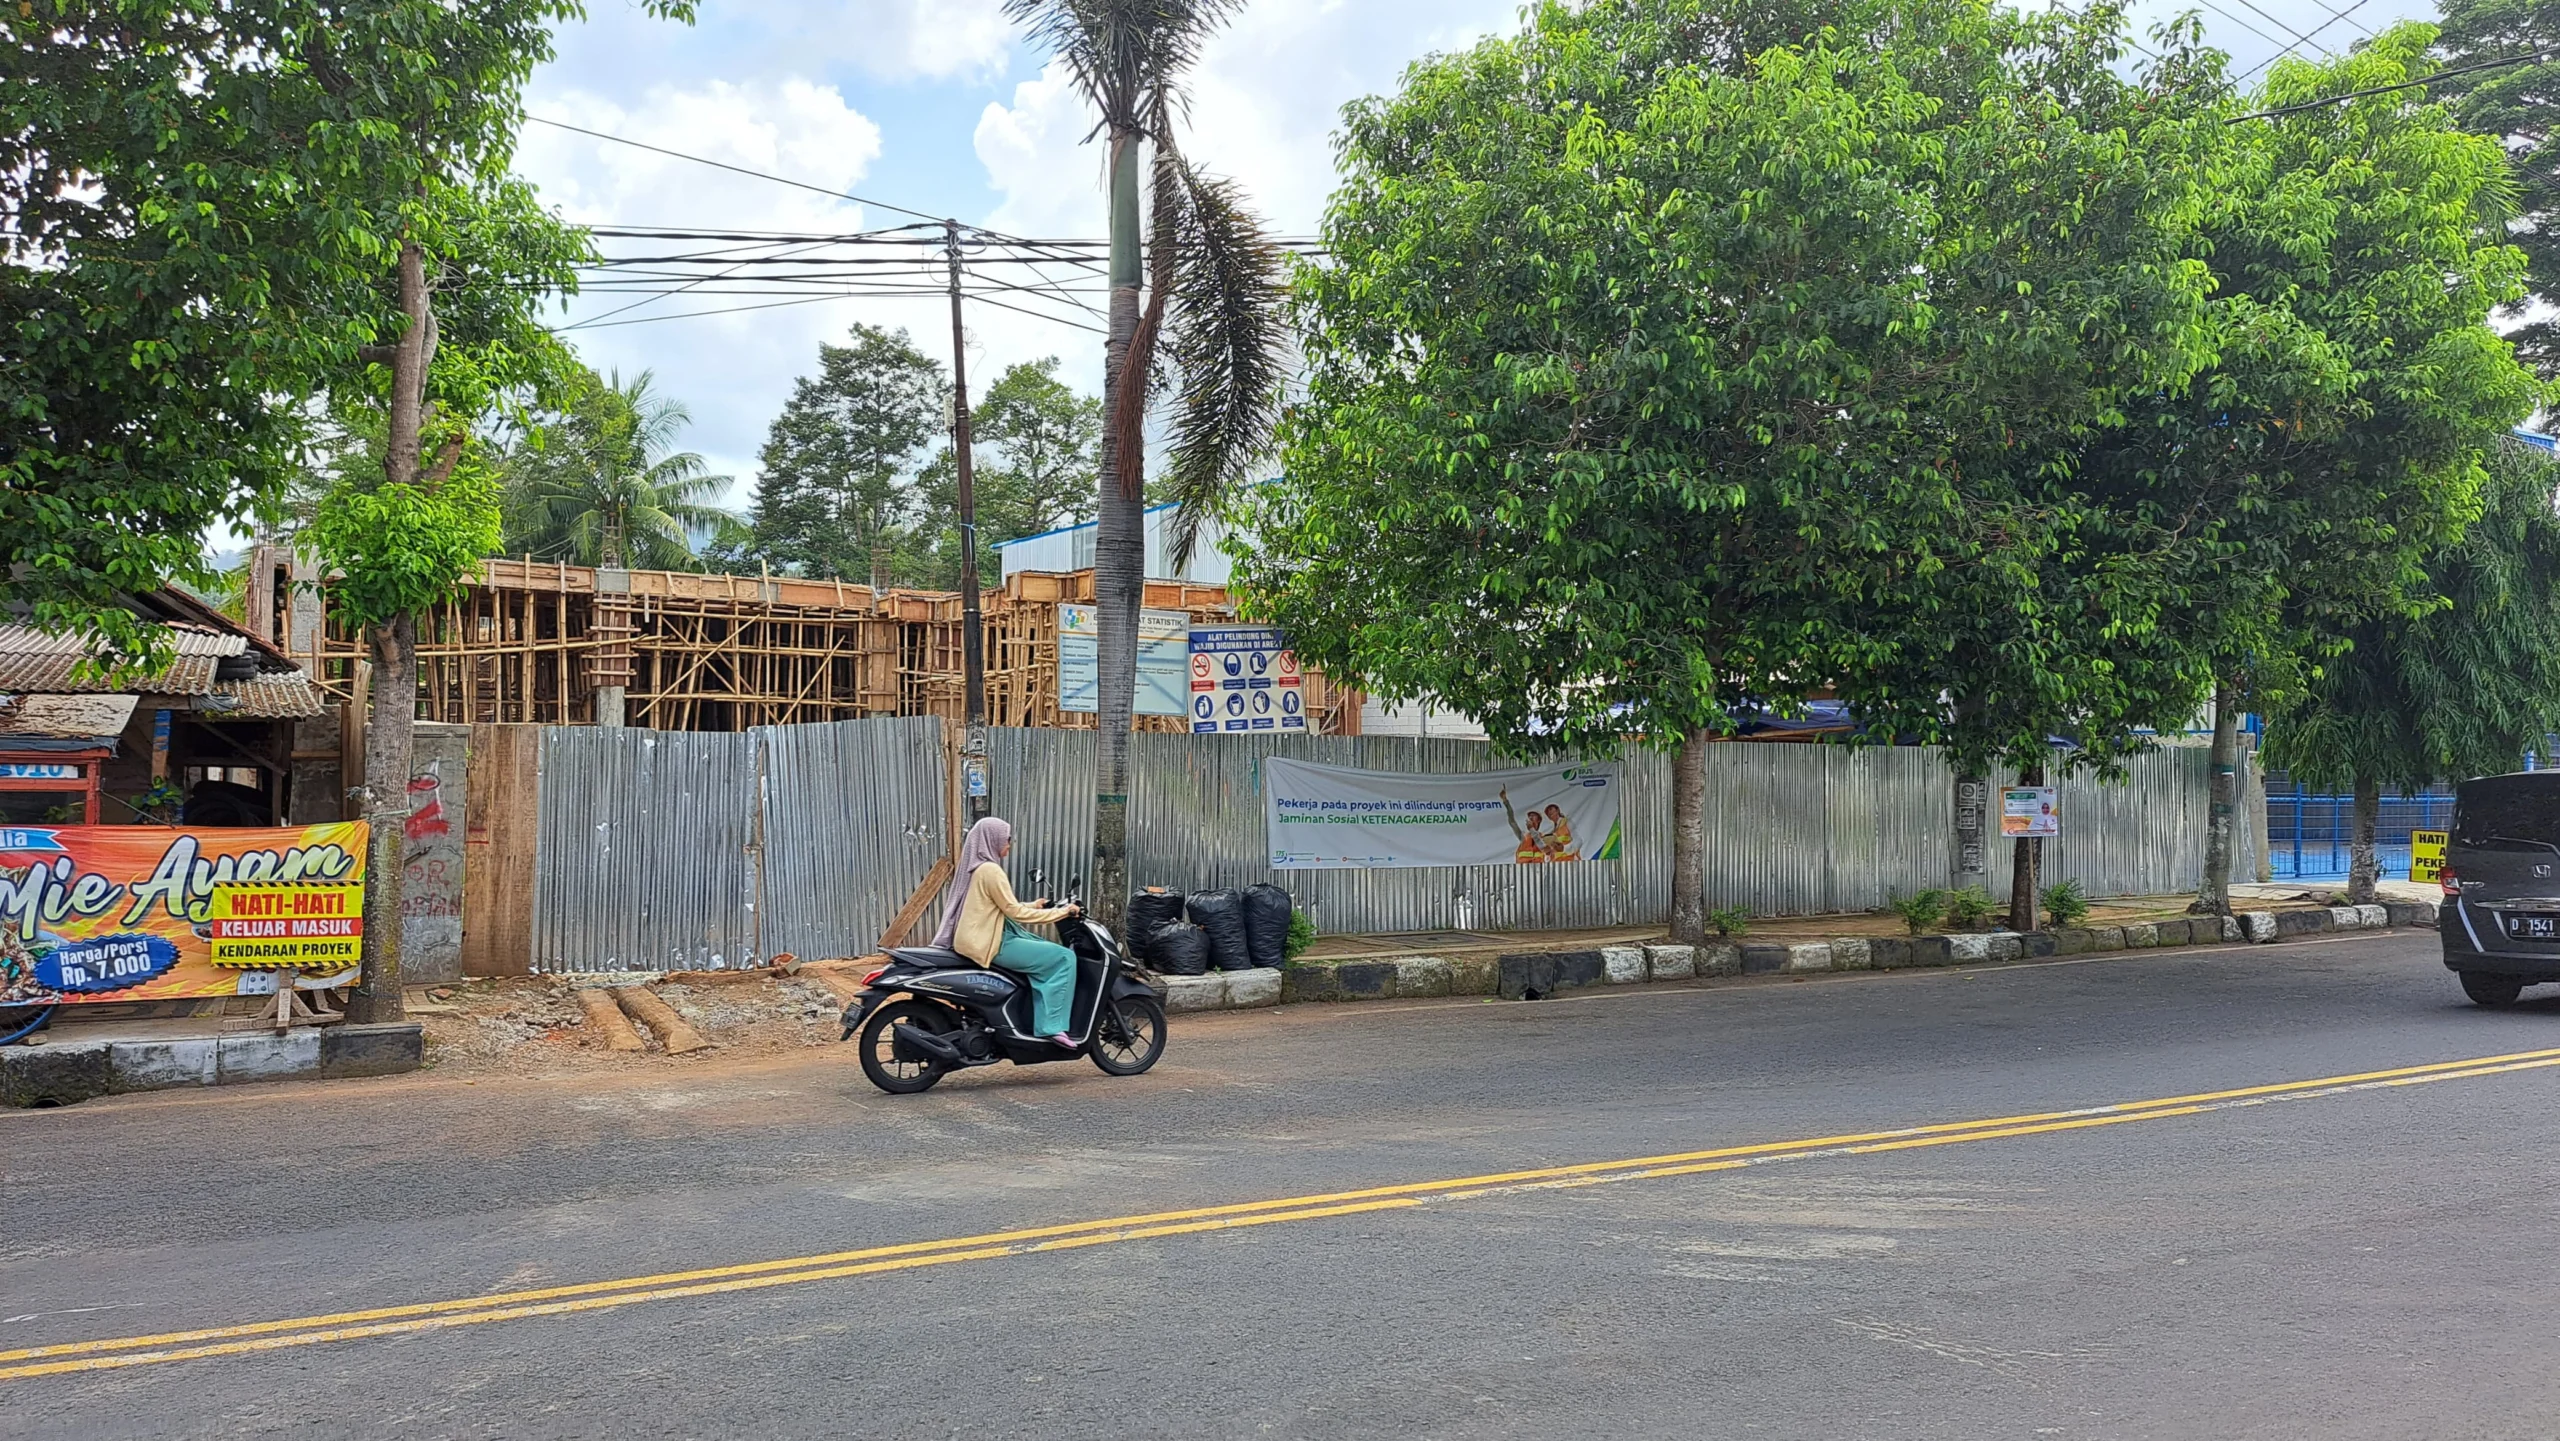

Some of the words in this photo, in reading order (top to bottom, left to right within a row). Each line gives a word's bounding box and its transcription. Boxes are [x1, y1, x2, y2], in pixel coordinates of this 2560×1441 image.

[1147, 616, 1183, 627] STATISTIK
[1207, 633, 1222, 642] ALAT
[1224, 632, 1259, 641] PELINDUNG
[1193, 642, 1215, 650] WAJIB
[1216, 641, 1252, 649] DIGUNAKAN
[1253, 640, 1260, 648] DI
[1277, 798, 1318, 810] Pekerja
[1321, 799, 1347, 811] pada
[1350, 800, 1387, 812] proyek
[1389, 800, 1402, 810] ini
[1404, 800, 1456, 812] dilindungi
[1458, 801, 1502, 811] program
[1278, 813, 1324, 824] Jaminan
[1327, 814, 1359, 824] Sosial
[1361, 814, 1467, 824] KETENAGAKERJAAN
[0, 855, 125, 941] Mie
[231, 893, 345, 915] HATI-HATI
[221, 920, 286, 937] KELUAR
[291, 919, 353, 935] MASUK
[2512, 918, 2519, 930] D
[2529, 919, 2553, 931] 1541
[60, 940, 148, 966] Harga/Porsi
[218, 944, 298, 957] KENDARAAN
[302, 943, 353, 956] PROYEK
[61, 966, 92, 987] Rp.
[96, 953, 151, 979] 7.000
